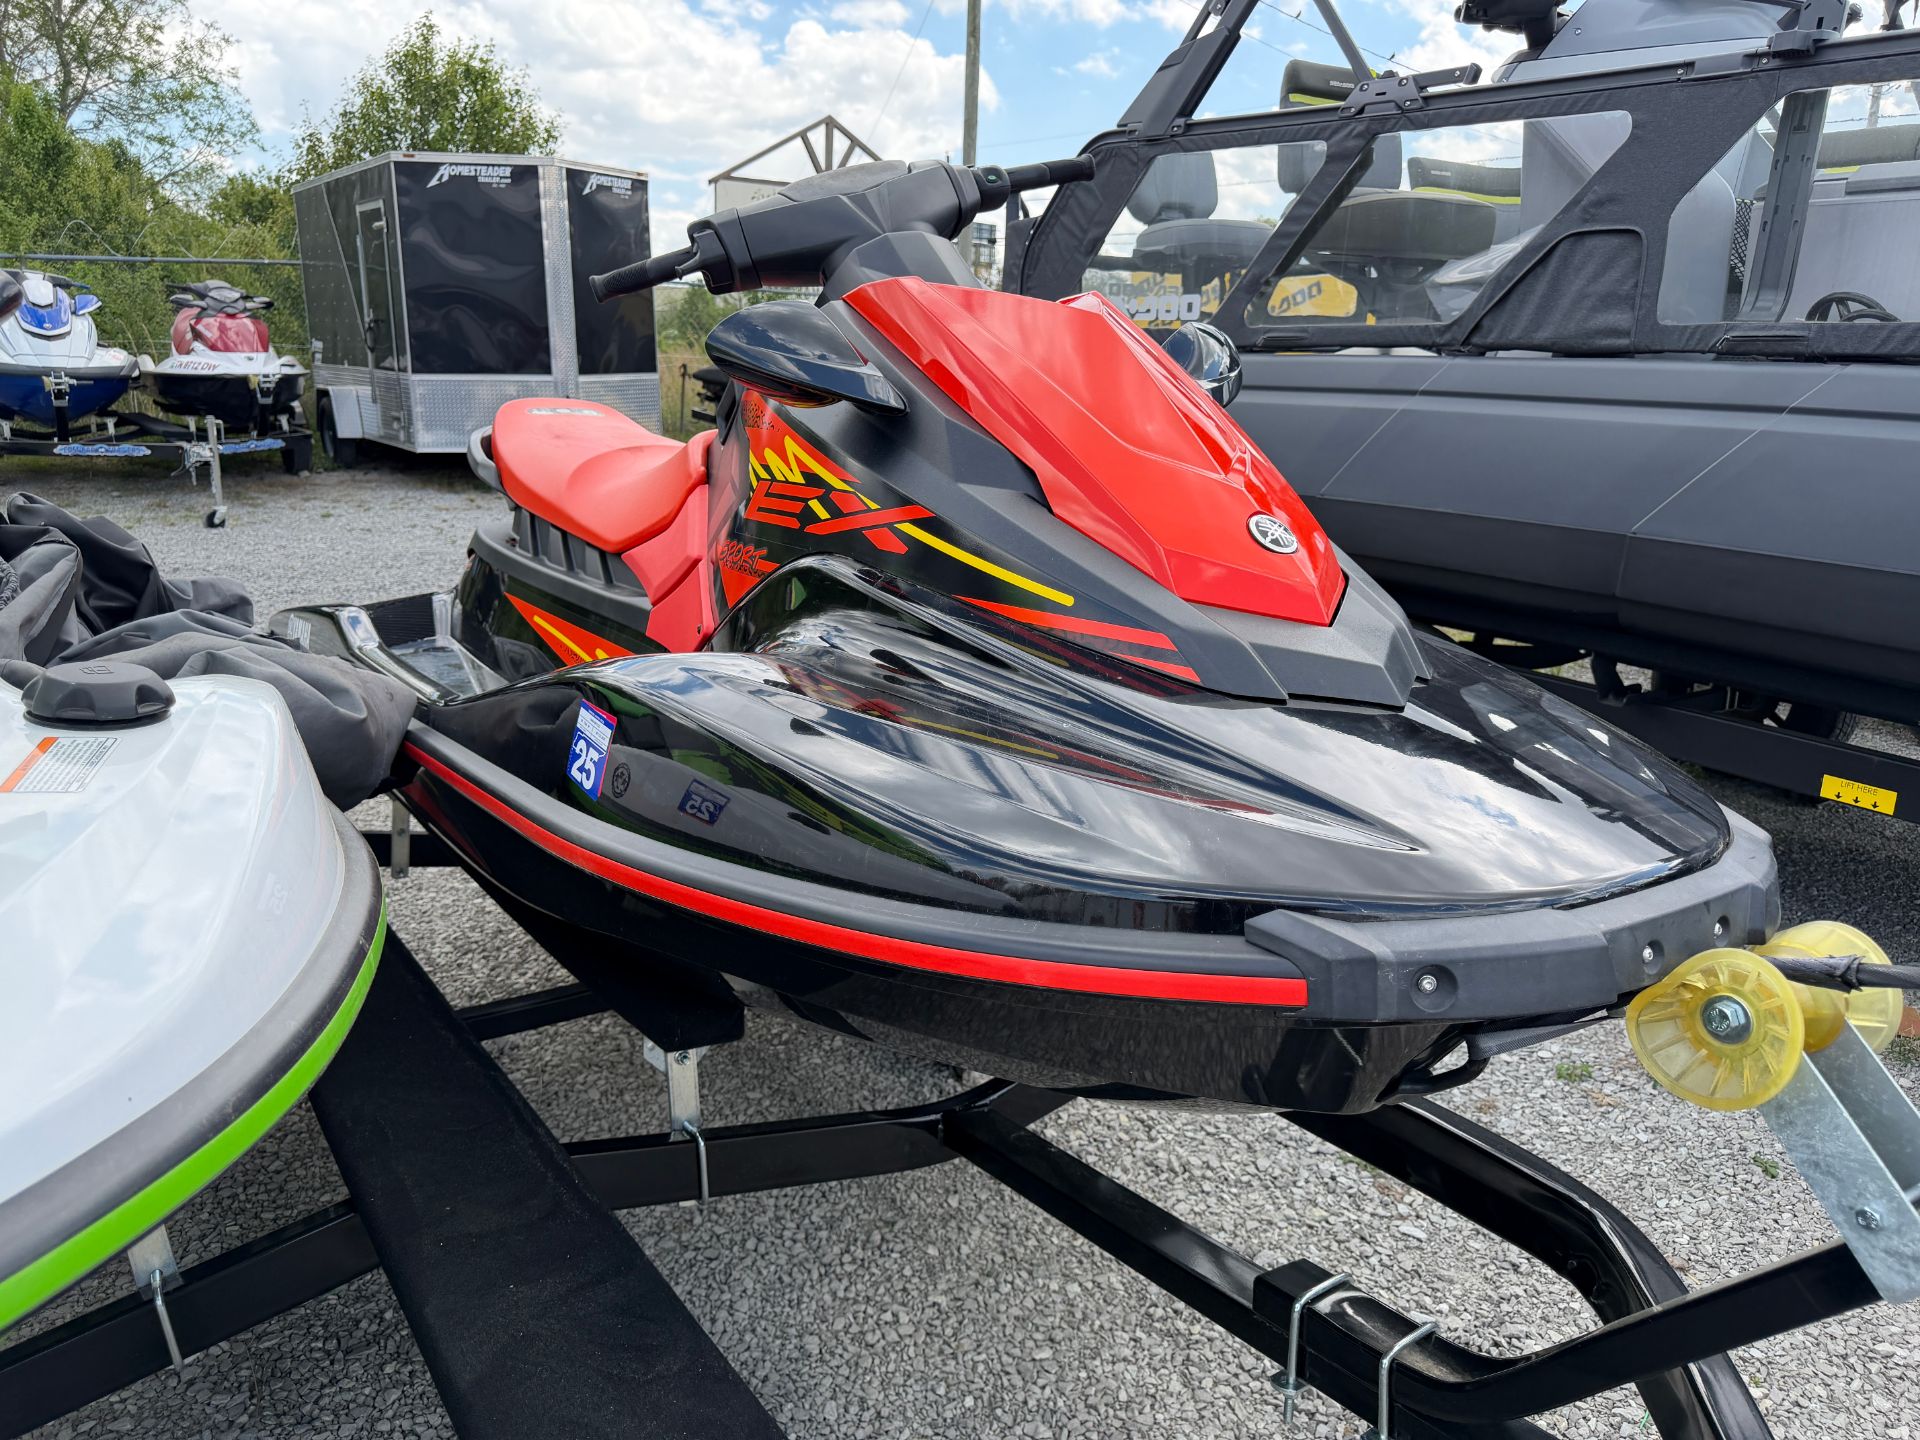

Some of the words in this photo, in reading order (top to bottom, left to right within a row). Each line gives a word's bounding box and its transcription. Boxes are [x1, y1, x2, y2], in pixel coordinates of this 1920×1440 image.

[426, 163, 513, 188] HOMESTEADER
[744, 481, 936, 555] EX
[570, 739, 600, 790] 25
[1840, 780, 1855, 790] LIFT
[1857, 784, 1879, 796] HERE
